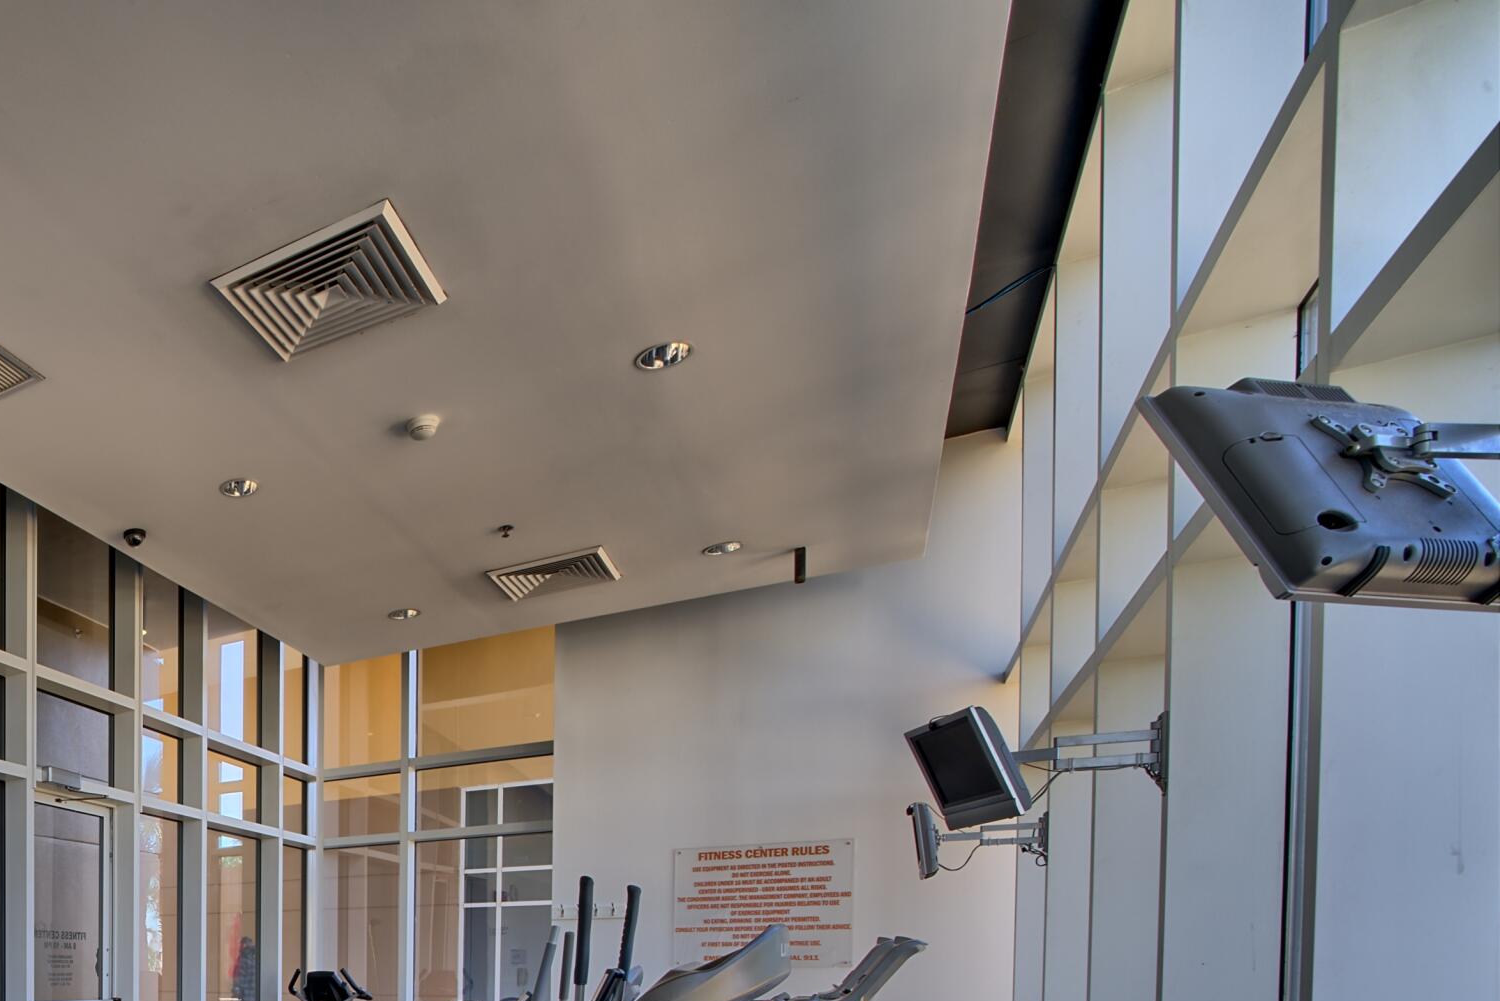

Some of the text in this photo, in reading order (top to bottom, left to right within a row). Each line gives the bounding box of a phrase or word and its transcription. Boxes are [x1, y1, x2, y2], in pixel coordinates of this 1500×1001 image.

[698, 845, 830, 861] FITNESS CENTER RULES
